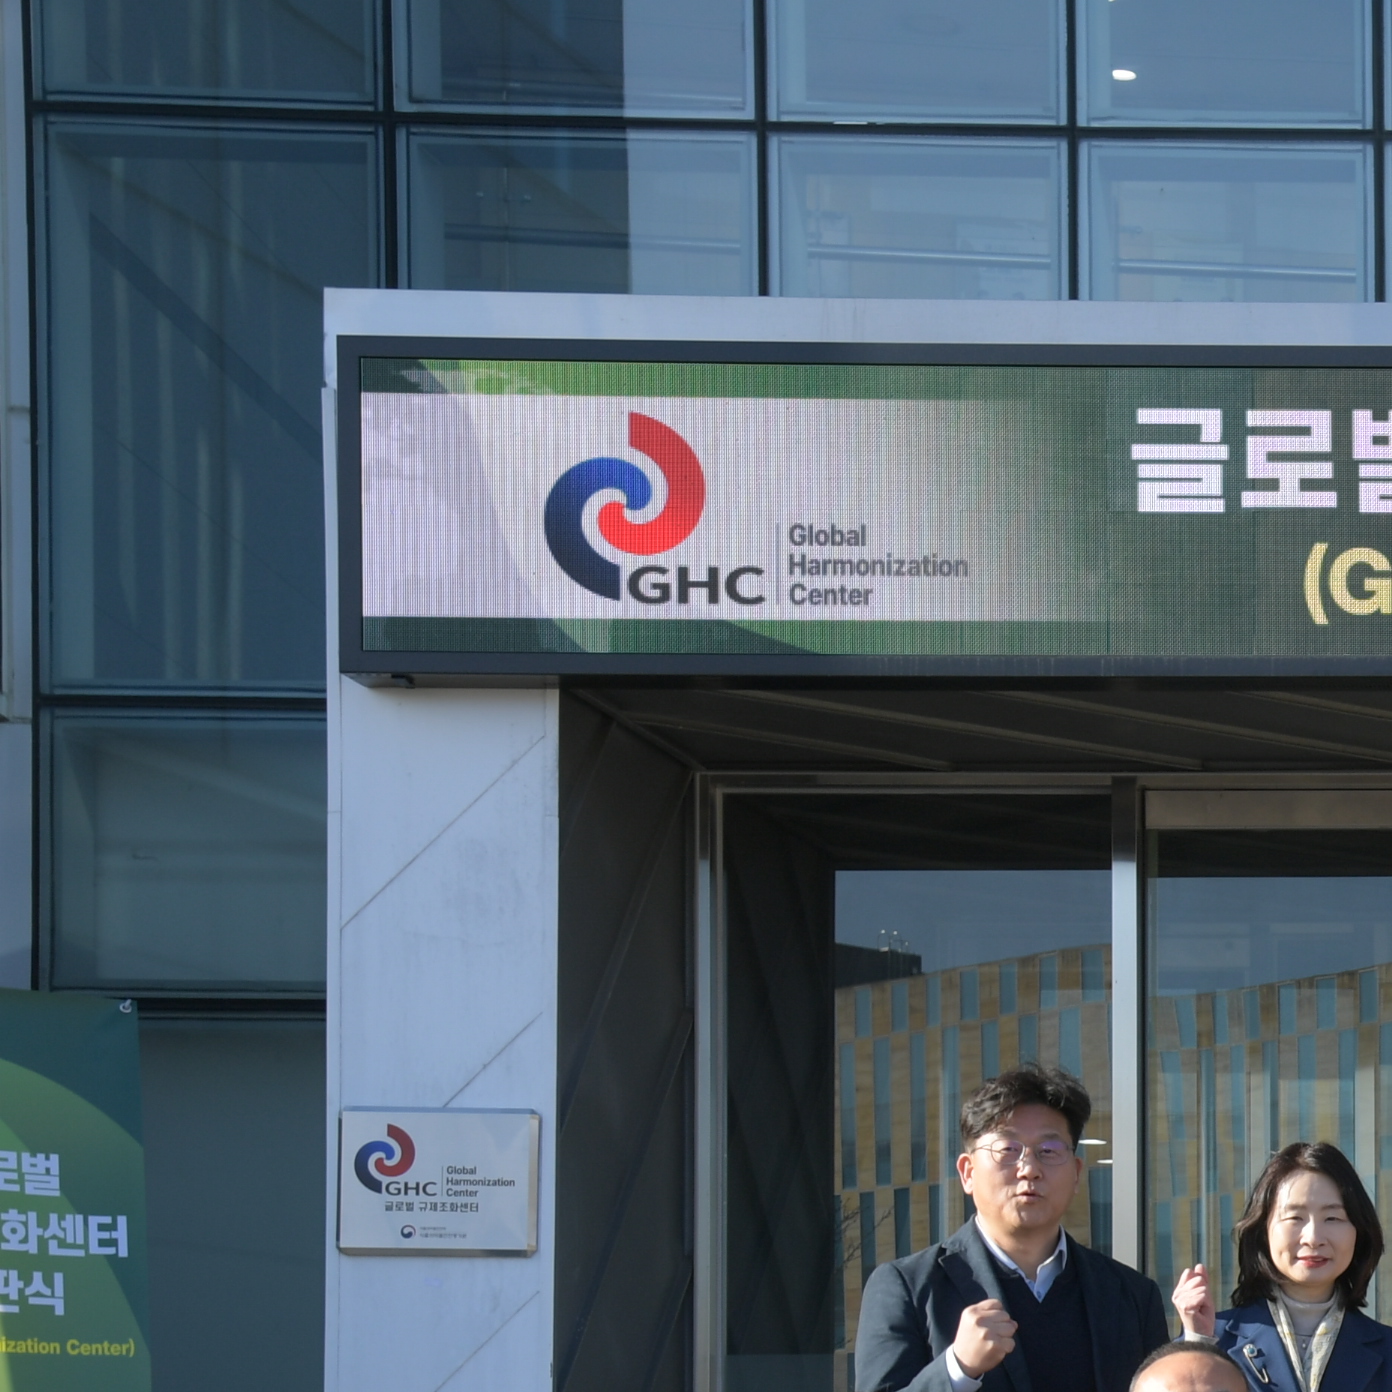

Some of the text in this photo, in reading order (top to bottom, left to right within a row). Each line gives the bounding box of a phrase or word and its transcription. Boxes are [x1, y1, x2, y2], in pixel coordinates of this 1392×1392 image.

[788, 524, 867, 547] Global
[788, 552, 969, 578] Harmonization
[626, 565, 766, 605] GHC
[788, 583, 873, 606] Center
[446, 1165, 477, 1175] Global
[446, 1176, 516, 1187] Harmonization
[384, 1181, 438, 1197] GHC
[446, 1188, 479, 1198] Center
[384, 1201, 479, 1213] 글로벌 규제조화센터
[0, 1208, 129, 1258] 화센터
[0, 1335, 136, 1358] ization Center)
